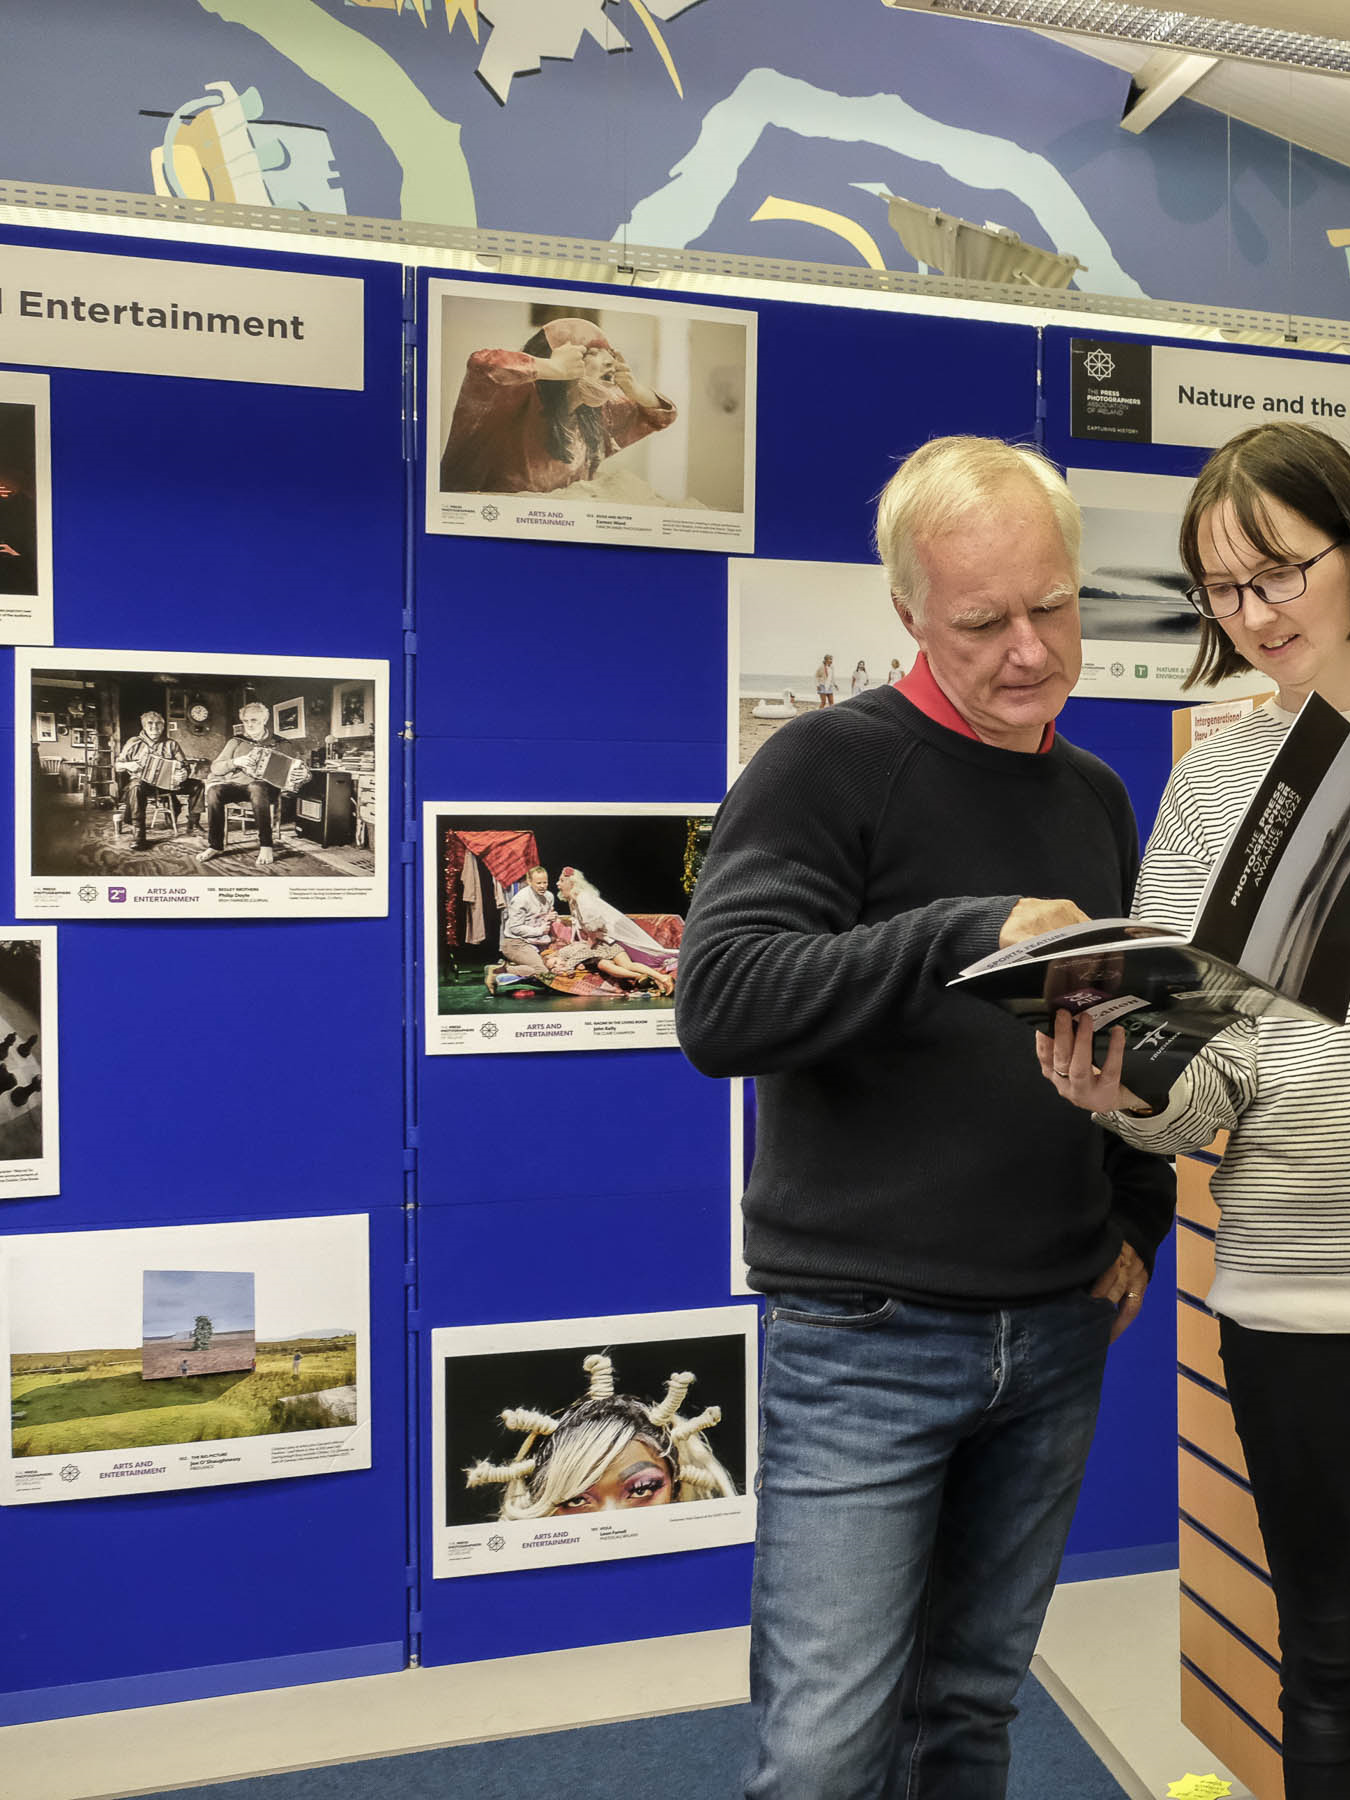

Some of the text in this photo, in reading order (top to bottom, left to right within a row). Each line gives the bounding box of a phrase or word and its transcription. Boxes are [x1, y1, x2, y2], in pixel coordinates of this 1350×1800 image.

[19, 290, 305, 341] Entertainment
[1087, 395, 1141, 405] PHOTOGRAPHERS
[1177, 384, 1256, 412] Nature
[1262, 395, 1304, 415] and
[1309, 397, 1347, 418] the
[528, 510, 564, 519] ARTS AND
[515, 517, 576, 527] ENTERTAINMENT
[1244, 781, 1286, 856] THE PRESS
[1252, 790, 1297, 873] OF THE YEAR
[1230, 784, 1292, 907] PHOTOGRAPHER
[1254, 794, 1302, 887] AWARDS 2022
[987, 949, 1024, 969] SPORTS
[526, 1023, 544, 1031] ARTS
[514, 1030, 574, 1038] ENTERTAINMENT
[113, 1460, 153, 1470] ARTS AND
[99, 1466, 167, 1479] ENTERTAINMENT
[522, 1537, 581, 1549] ENTERTAINMENT
